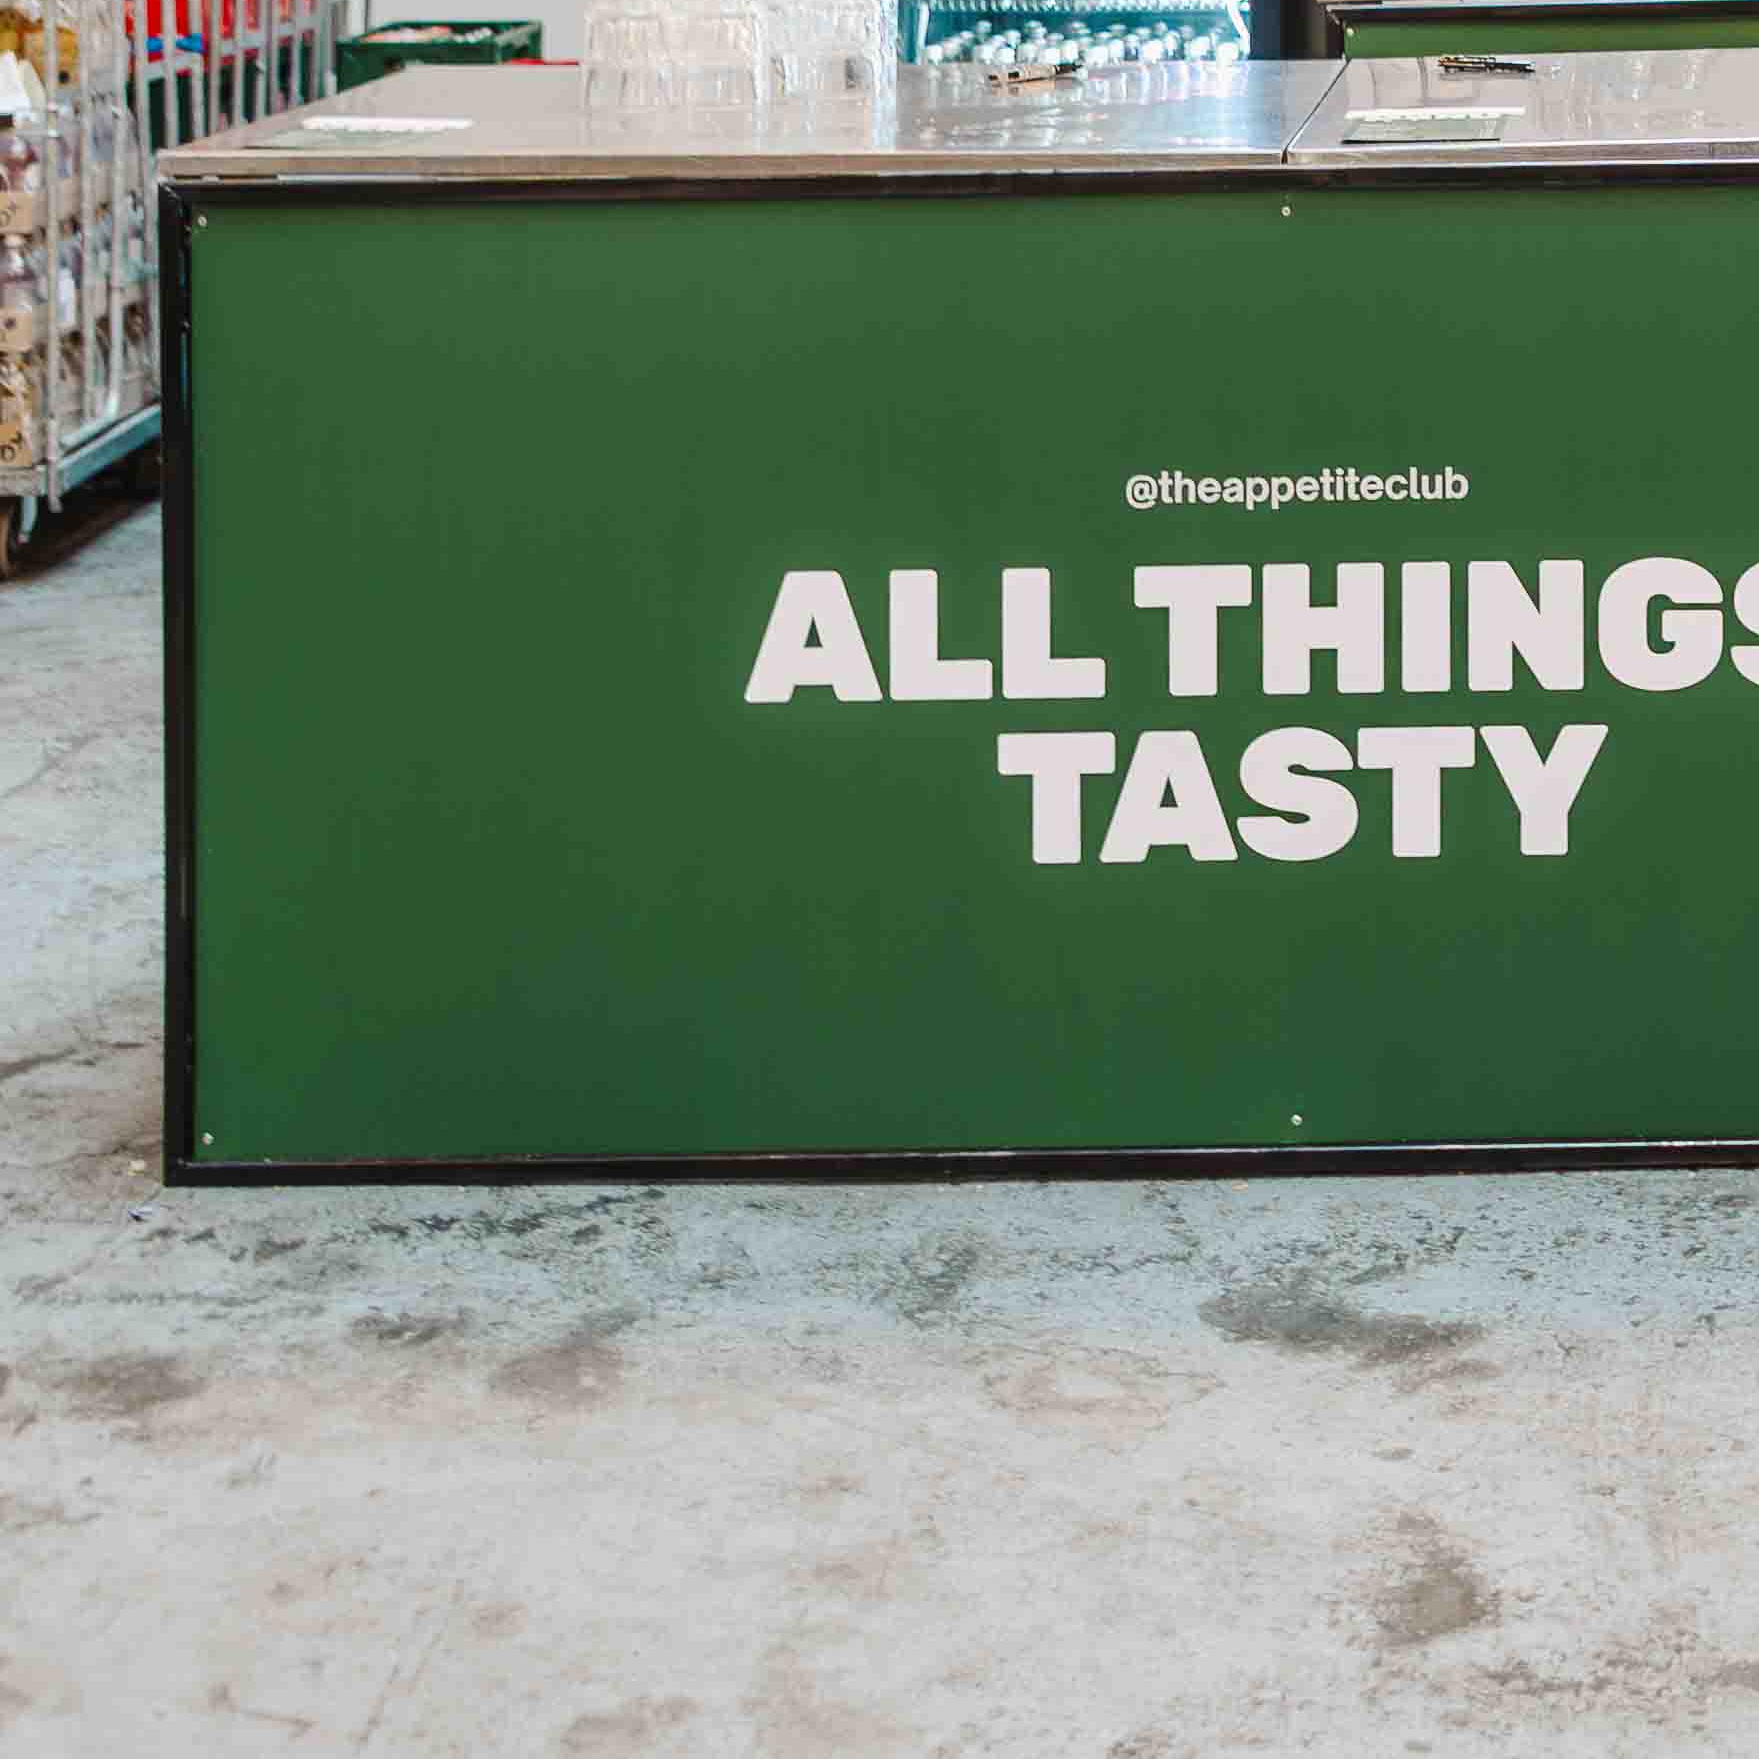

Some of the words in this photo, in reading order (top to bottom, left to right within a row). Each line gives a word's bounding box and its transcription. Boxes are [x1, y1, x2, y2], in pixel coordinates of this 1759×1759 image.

[1125, 466, 1469, 511] @theappetiteclub
[744, 568, 1106, 703] ALL
[997, 724, 1609, 864] TASTY
